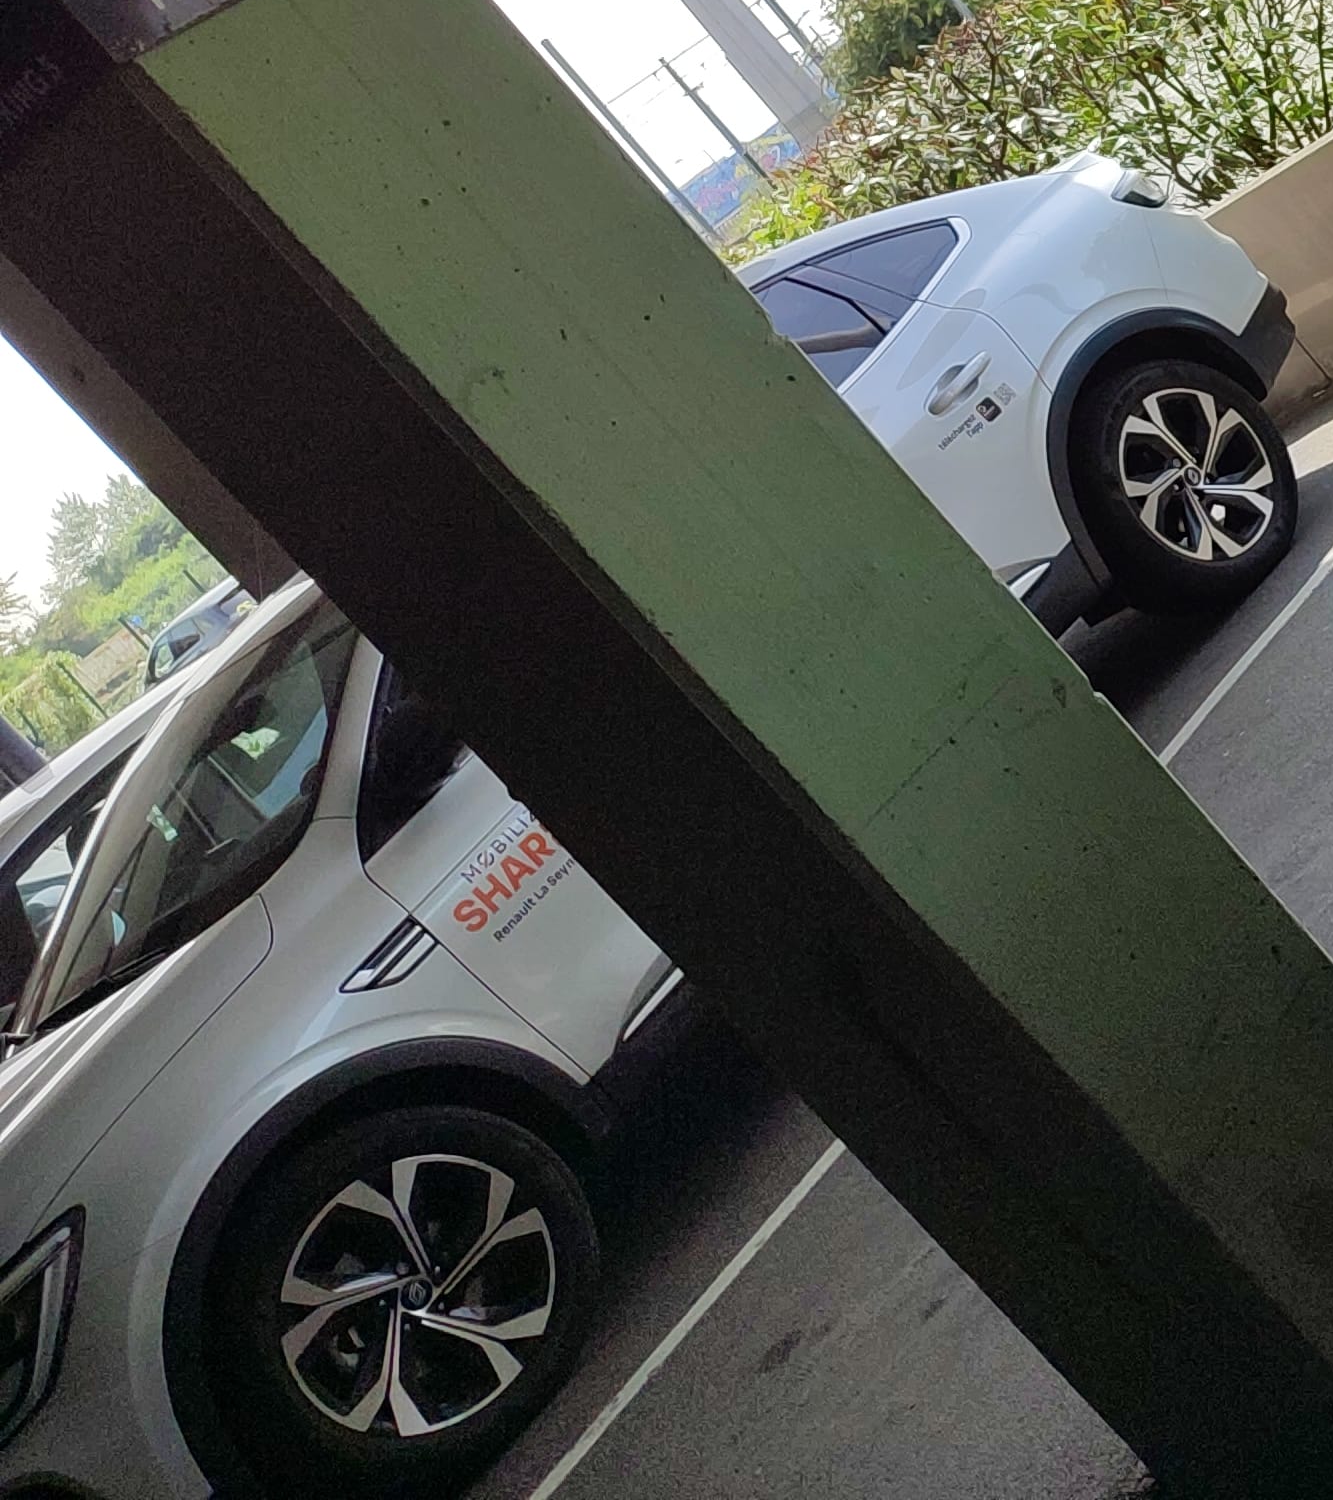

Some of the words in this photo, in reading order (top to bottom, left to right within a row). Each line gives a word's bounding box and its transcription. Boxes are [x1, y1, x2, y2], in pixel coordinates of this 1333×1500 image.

[453, 825, 560, 933] SHAR
[493, 897, 537, 942] Renault
[533, 883, 551, 900] La
